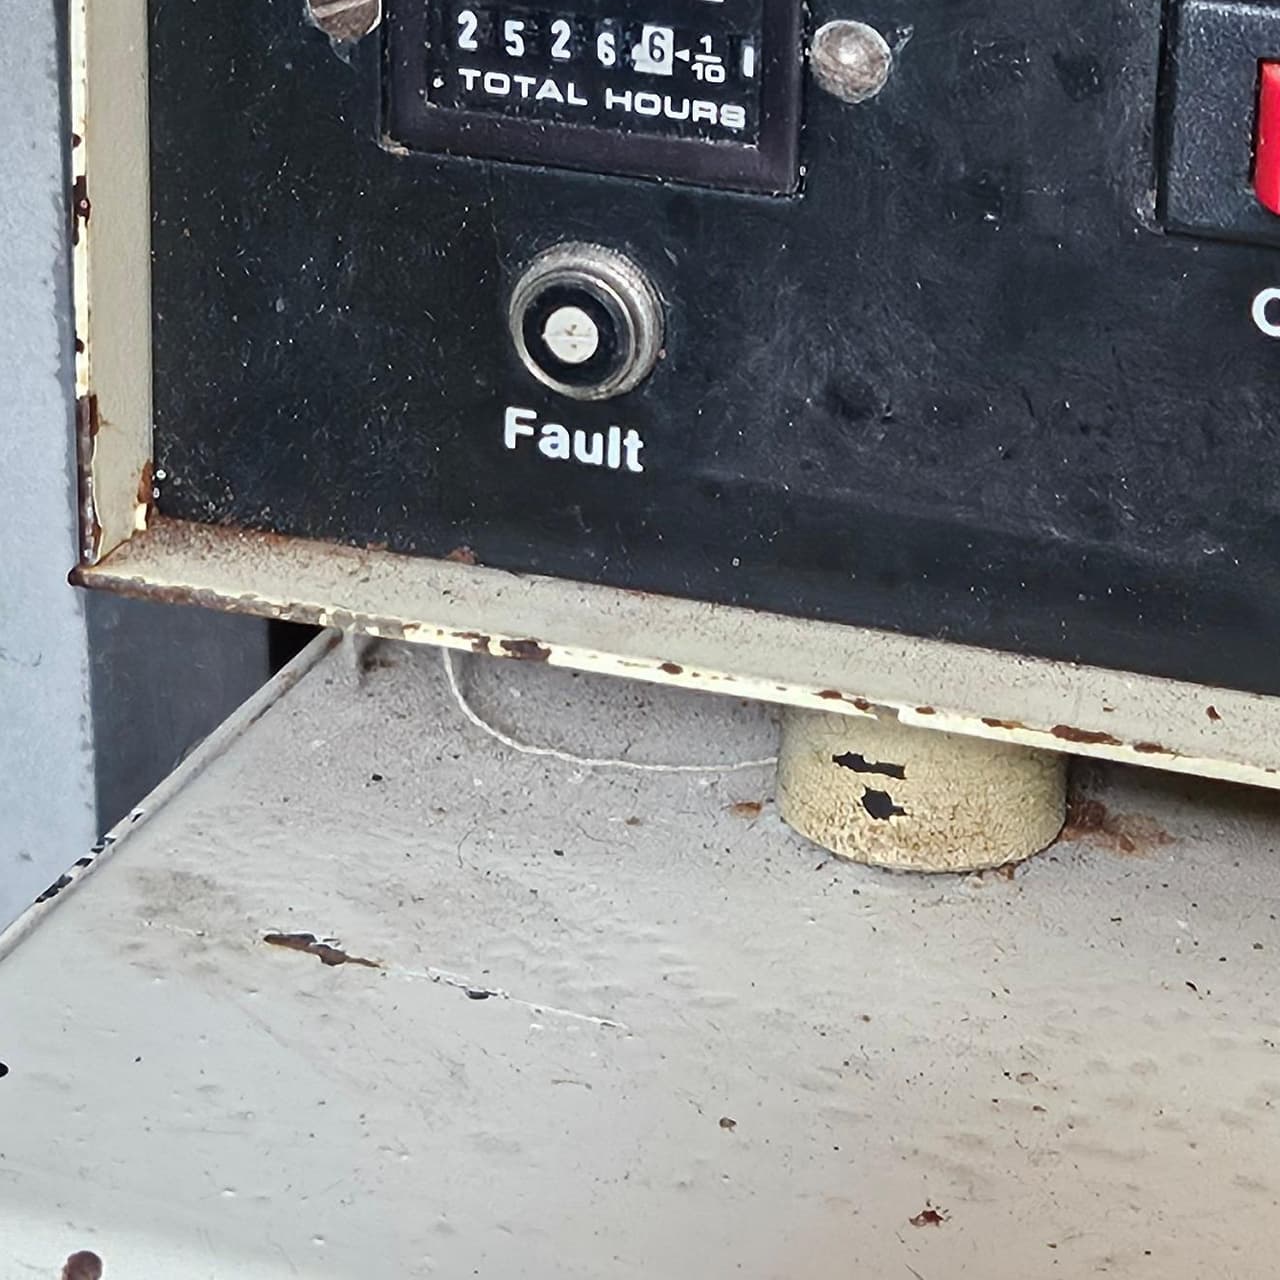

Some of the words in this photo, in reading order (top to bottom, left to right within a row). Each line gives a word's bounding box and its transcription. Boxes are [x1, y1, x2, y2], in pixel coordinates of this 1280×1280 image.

[458, 68, 588, 106] TOTAL
[605, 87, 746, 130] HOURS
[504, 406, 644, 473] Fault
